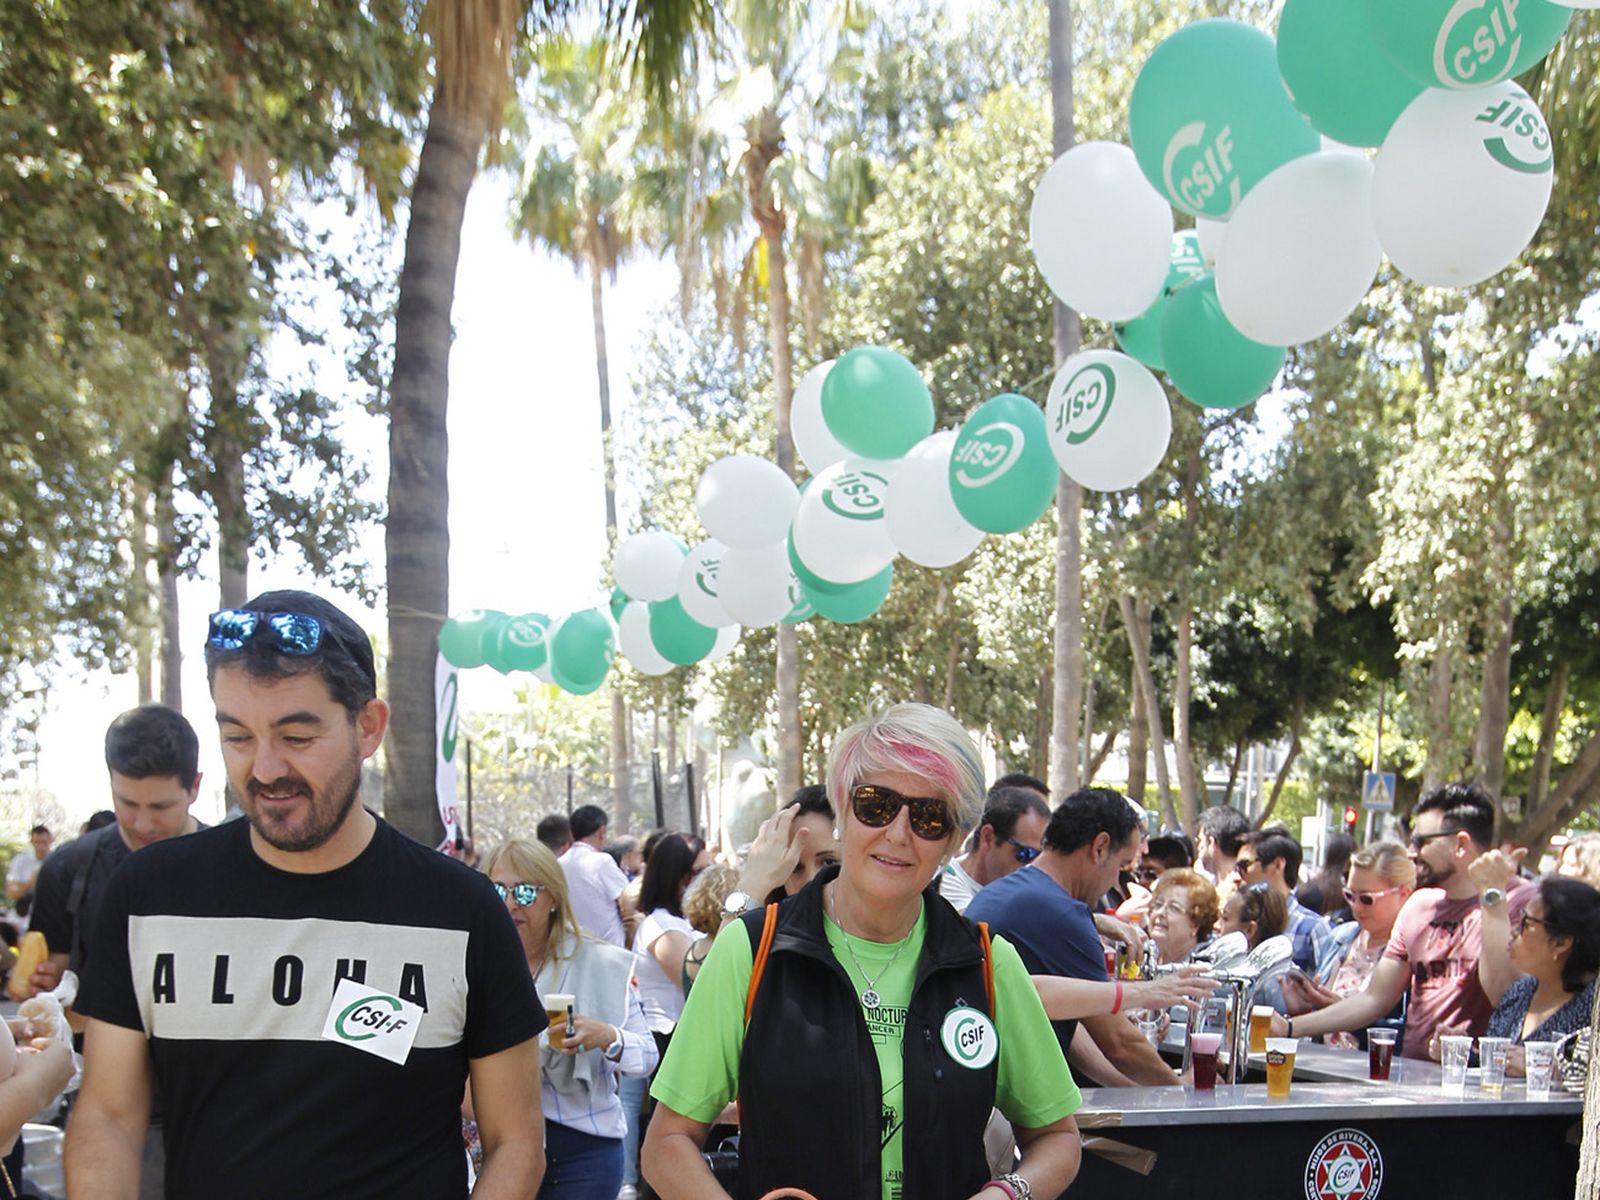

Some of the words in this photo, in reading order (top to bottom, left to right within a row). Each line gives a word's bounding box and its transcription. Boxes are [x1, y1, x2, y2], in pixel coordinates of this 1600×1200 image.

[1475, 100, 1550, 151] CSIF
[1180, 124, 1233, 209] CSIF
[1056, 381, 1102, 433] CSIF
[955, 440, 1007, 468] CSIF
[153, 952, 428, 1014] ALOHA
[960, 1025, 985, 1048] CSIF
[1310, 1141, 1328, 1170] HIJOS
[1327, 1134, 1339, 1146] DE
